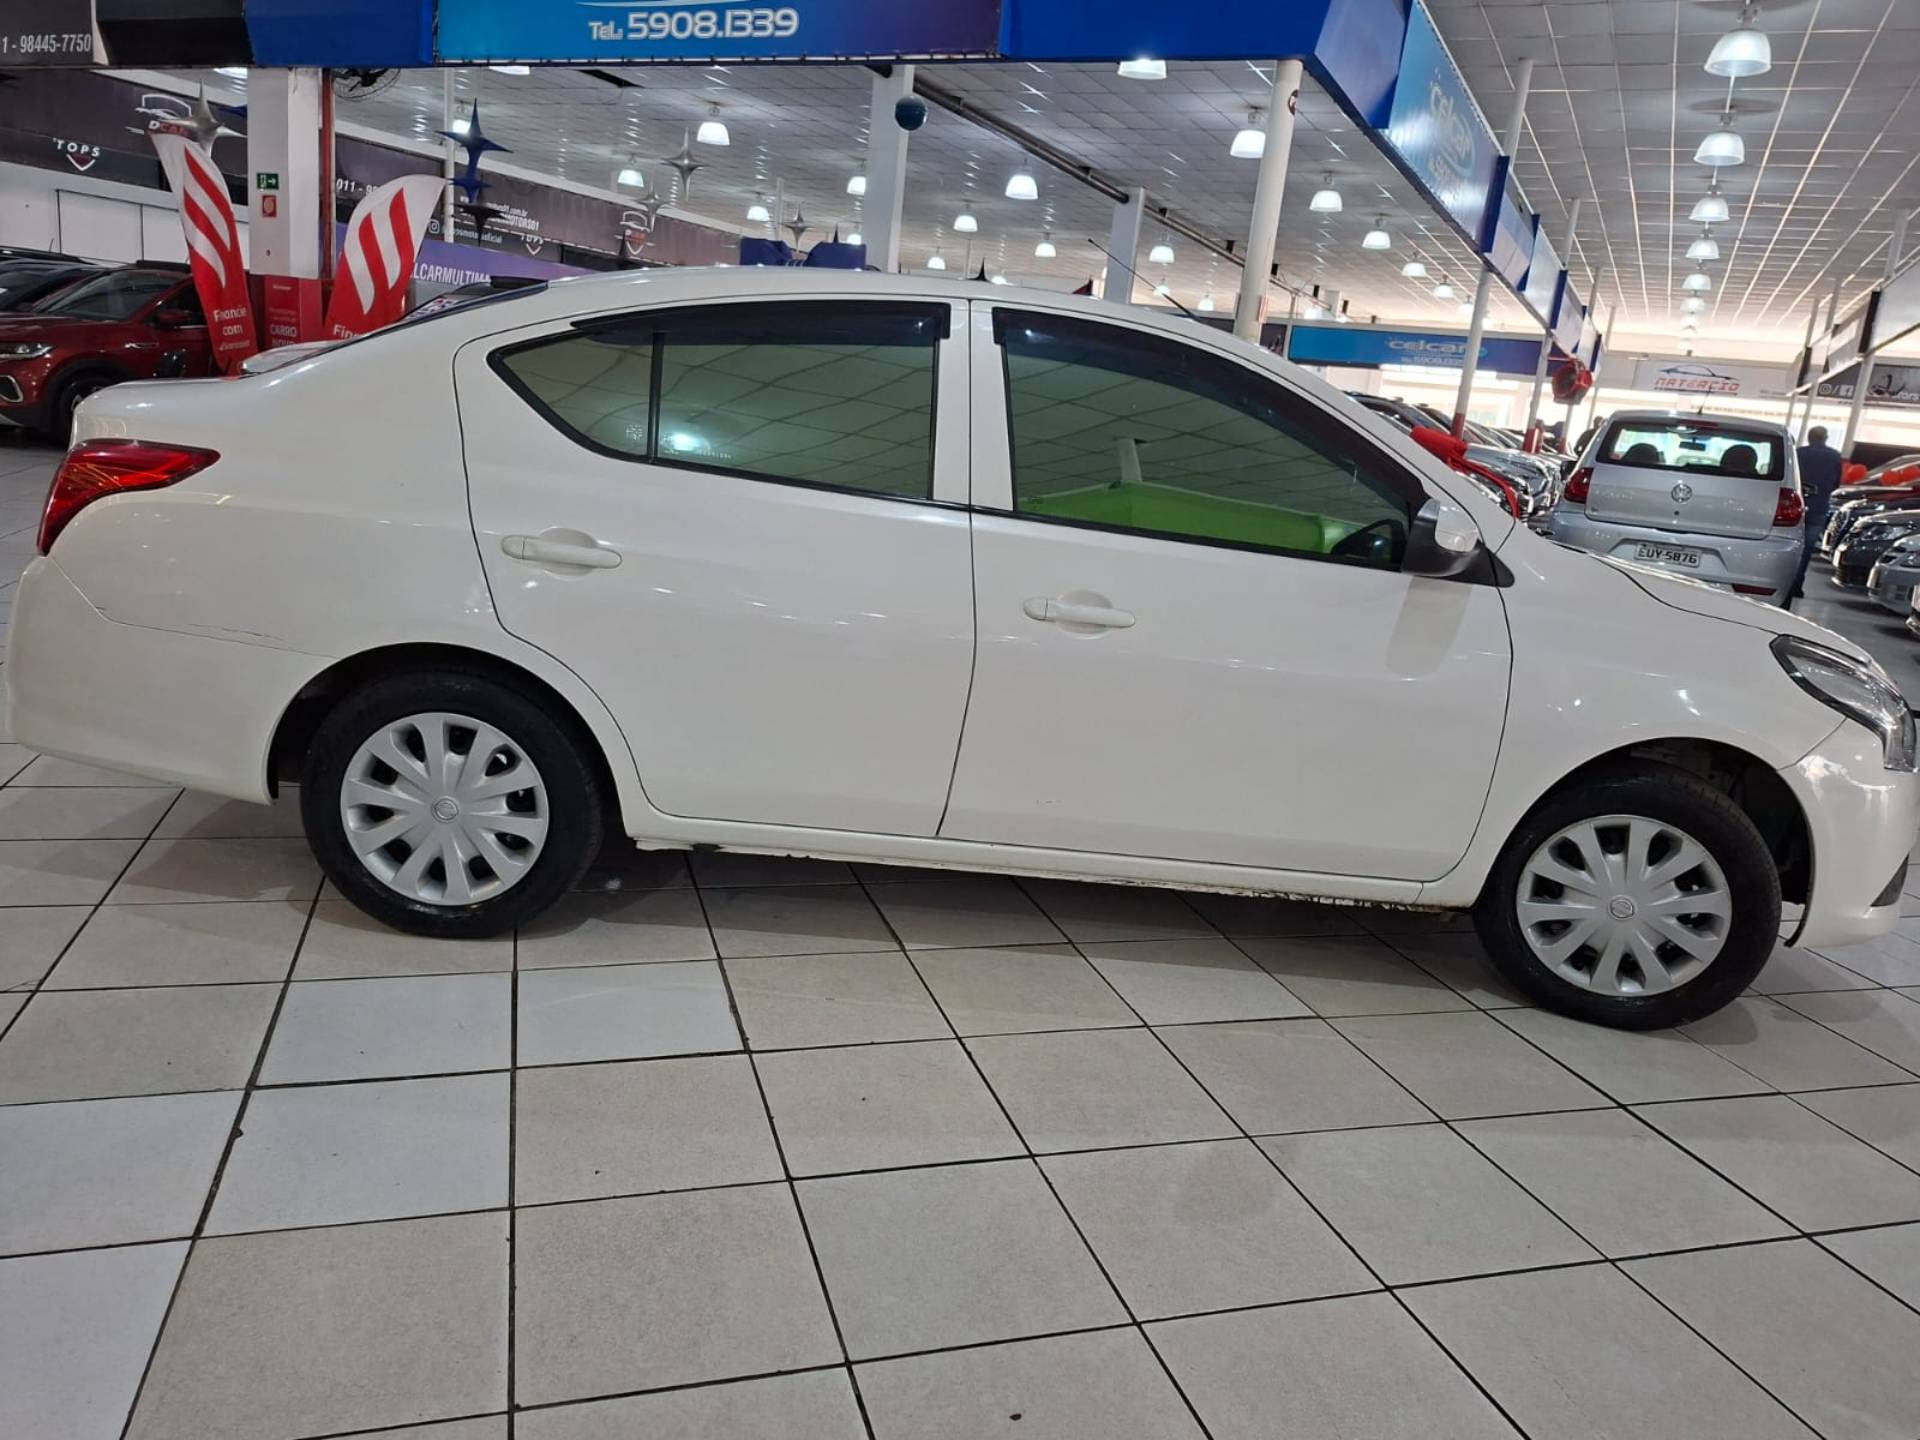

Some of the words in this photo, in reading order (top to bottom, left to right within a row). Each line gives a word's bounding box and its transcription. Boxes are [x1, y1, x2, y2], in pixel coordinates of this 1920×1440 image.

[627, 8, 798, 40] 5908.1339
[20, 33, 92, 53] 98445-7750
[54, 138, 101, 158] TOPS
[332, 323, 360, 340] Fin
[1388, 337, 1466, 355] celcar
